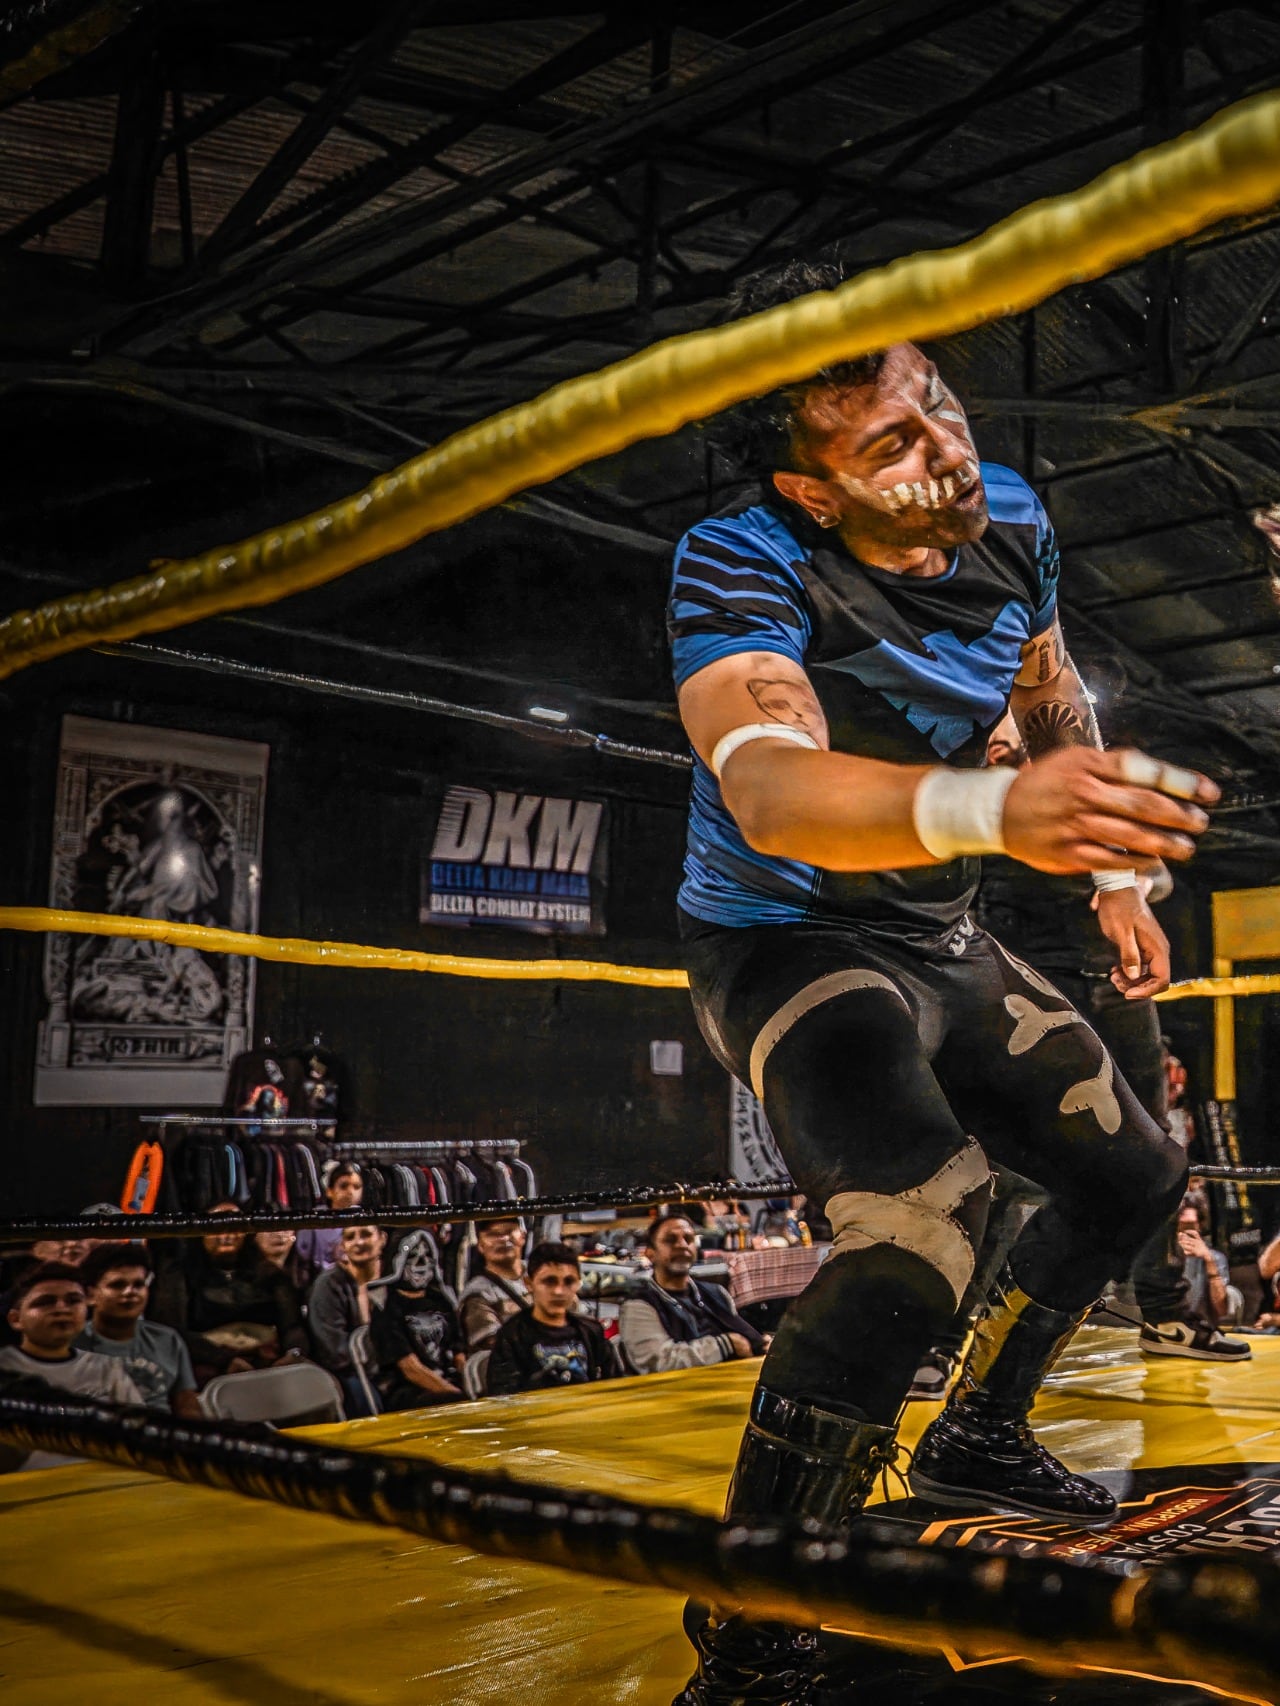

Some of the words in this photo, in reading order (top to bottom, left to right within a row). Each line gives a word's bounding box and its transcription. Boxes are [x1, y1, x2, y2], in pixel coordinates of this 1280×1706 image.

[430, 784, 602, 873] DKM
[430, 893, 474, 914] DELTA
[476, 896, 537, 919] COMBAT
[537, 901, 591, 923] SYSTEM
